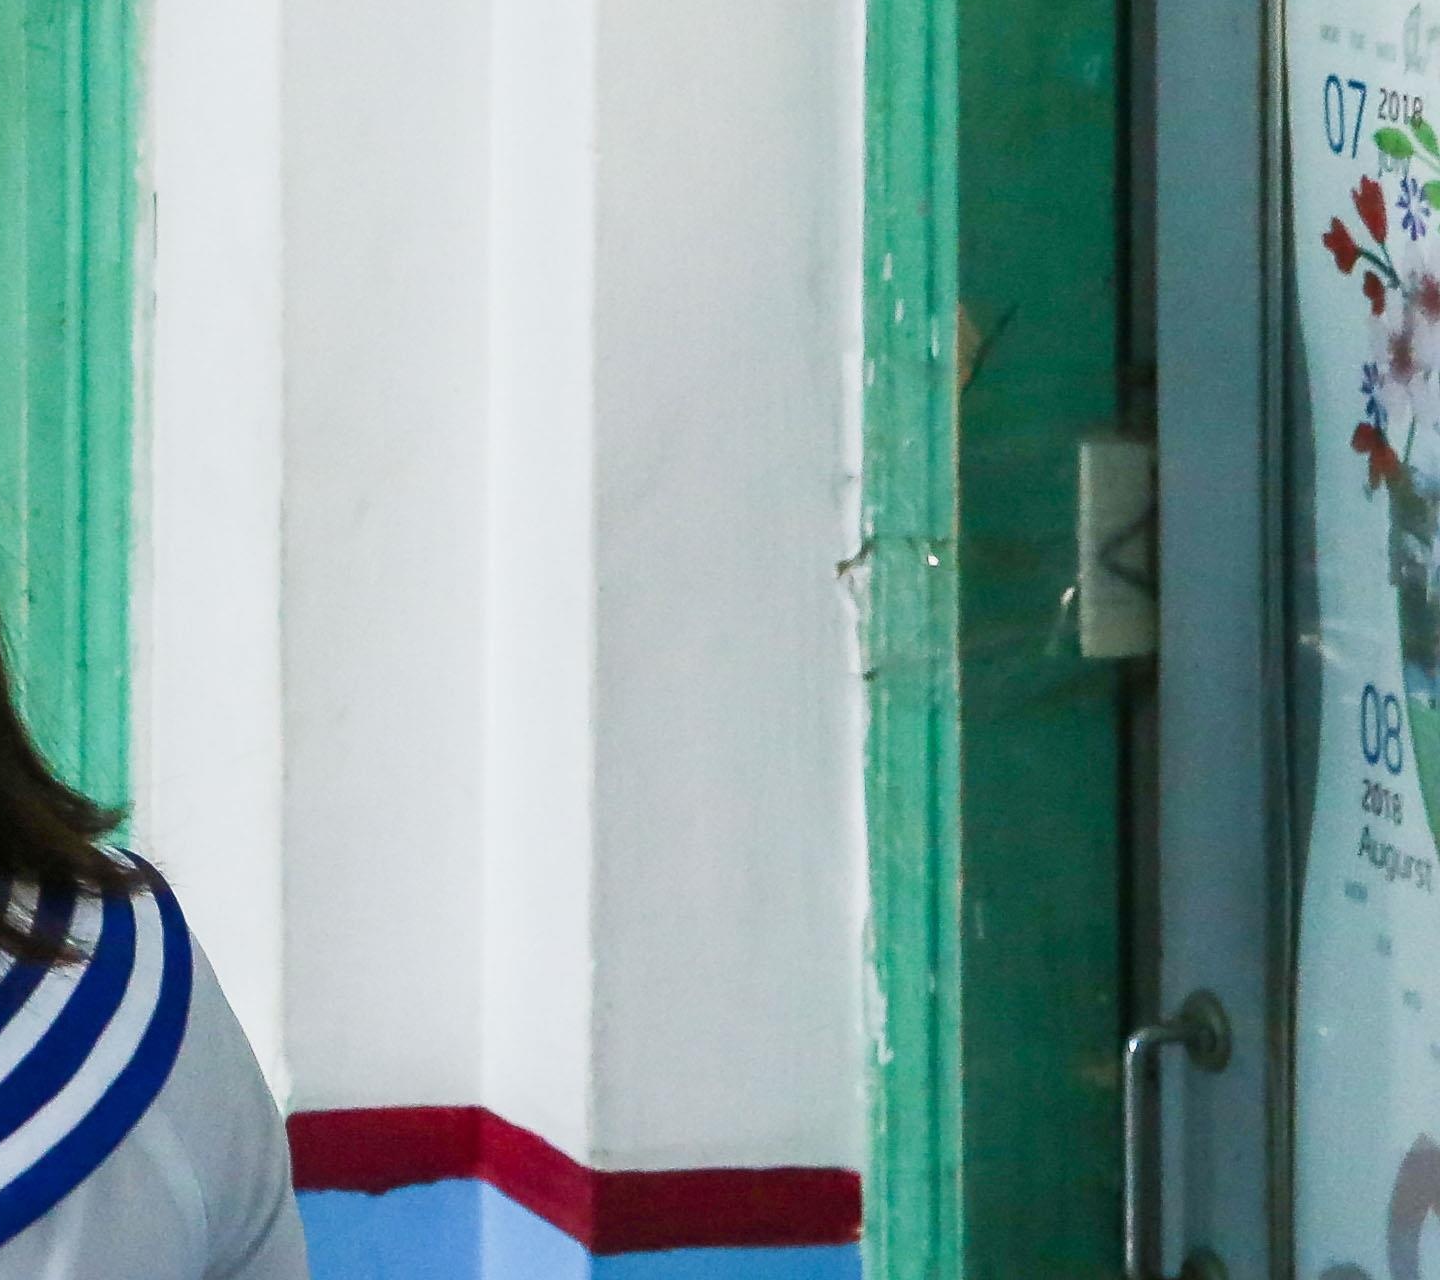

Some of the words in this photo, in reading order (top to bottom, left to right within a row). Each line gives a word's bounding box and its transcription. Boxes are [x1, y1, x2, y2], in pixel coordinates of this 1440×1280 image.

[1324, 74, 1367, 159] 07
[1378, 86, 1424, 128] 2018
[1361, 683, 1404, 775] 08
